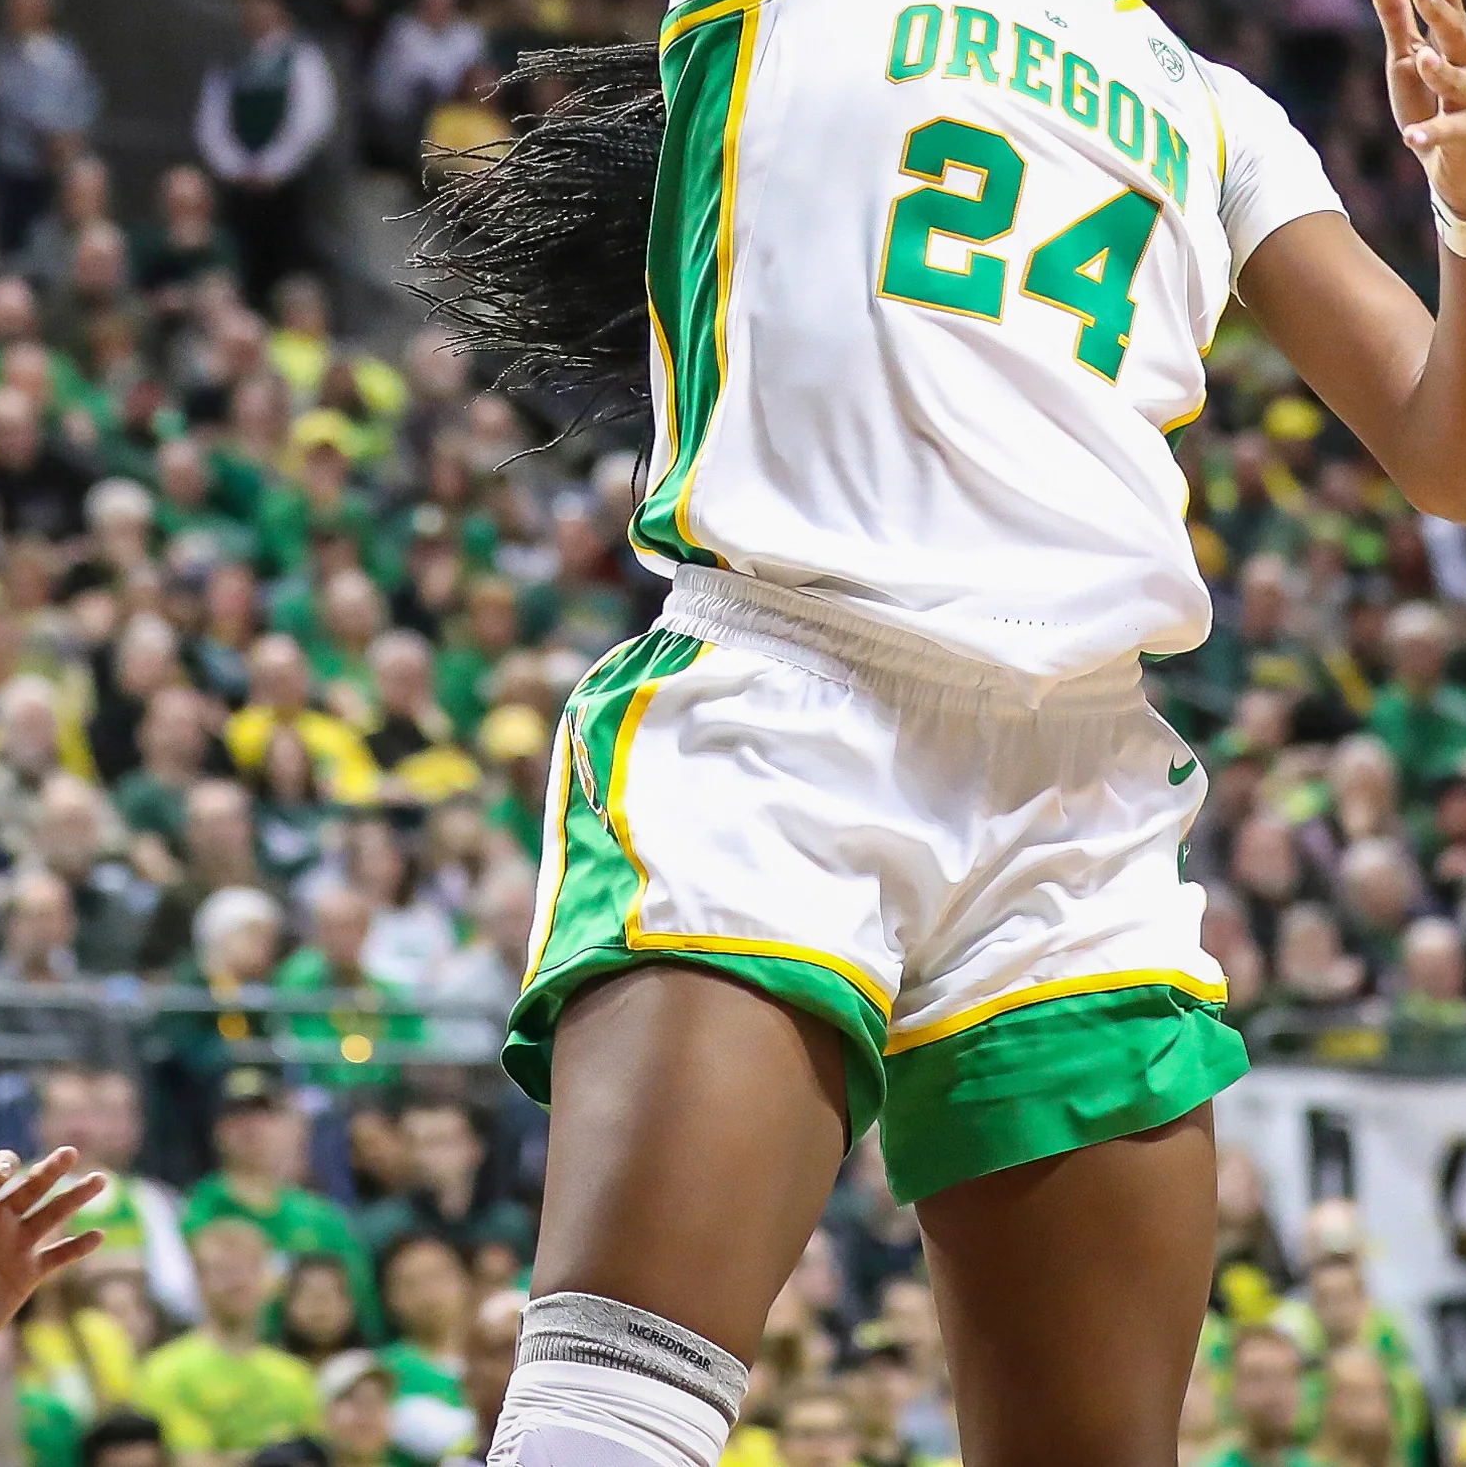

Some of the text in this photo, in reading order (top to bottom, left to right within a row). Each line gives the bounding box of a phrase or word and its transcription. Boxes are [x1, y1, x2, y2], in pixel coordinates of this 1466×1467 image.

[885, 2, 1190, 216] OREGON
[876, 116, 1164, 388] 24
[627, 1321, 712, 1372] INCREDIWEAR
